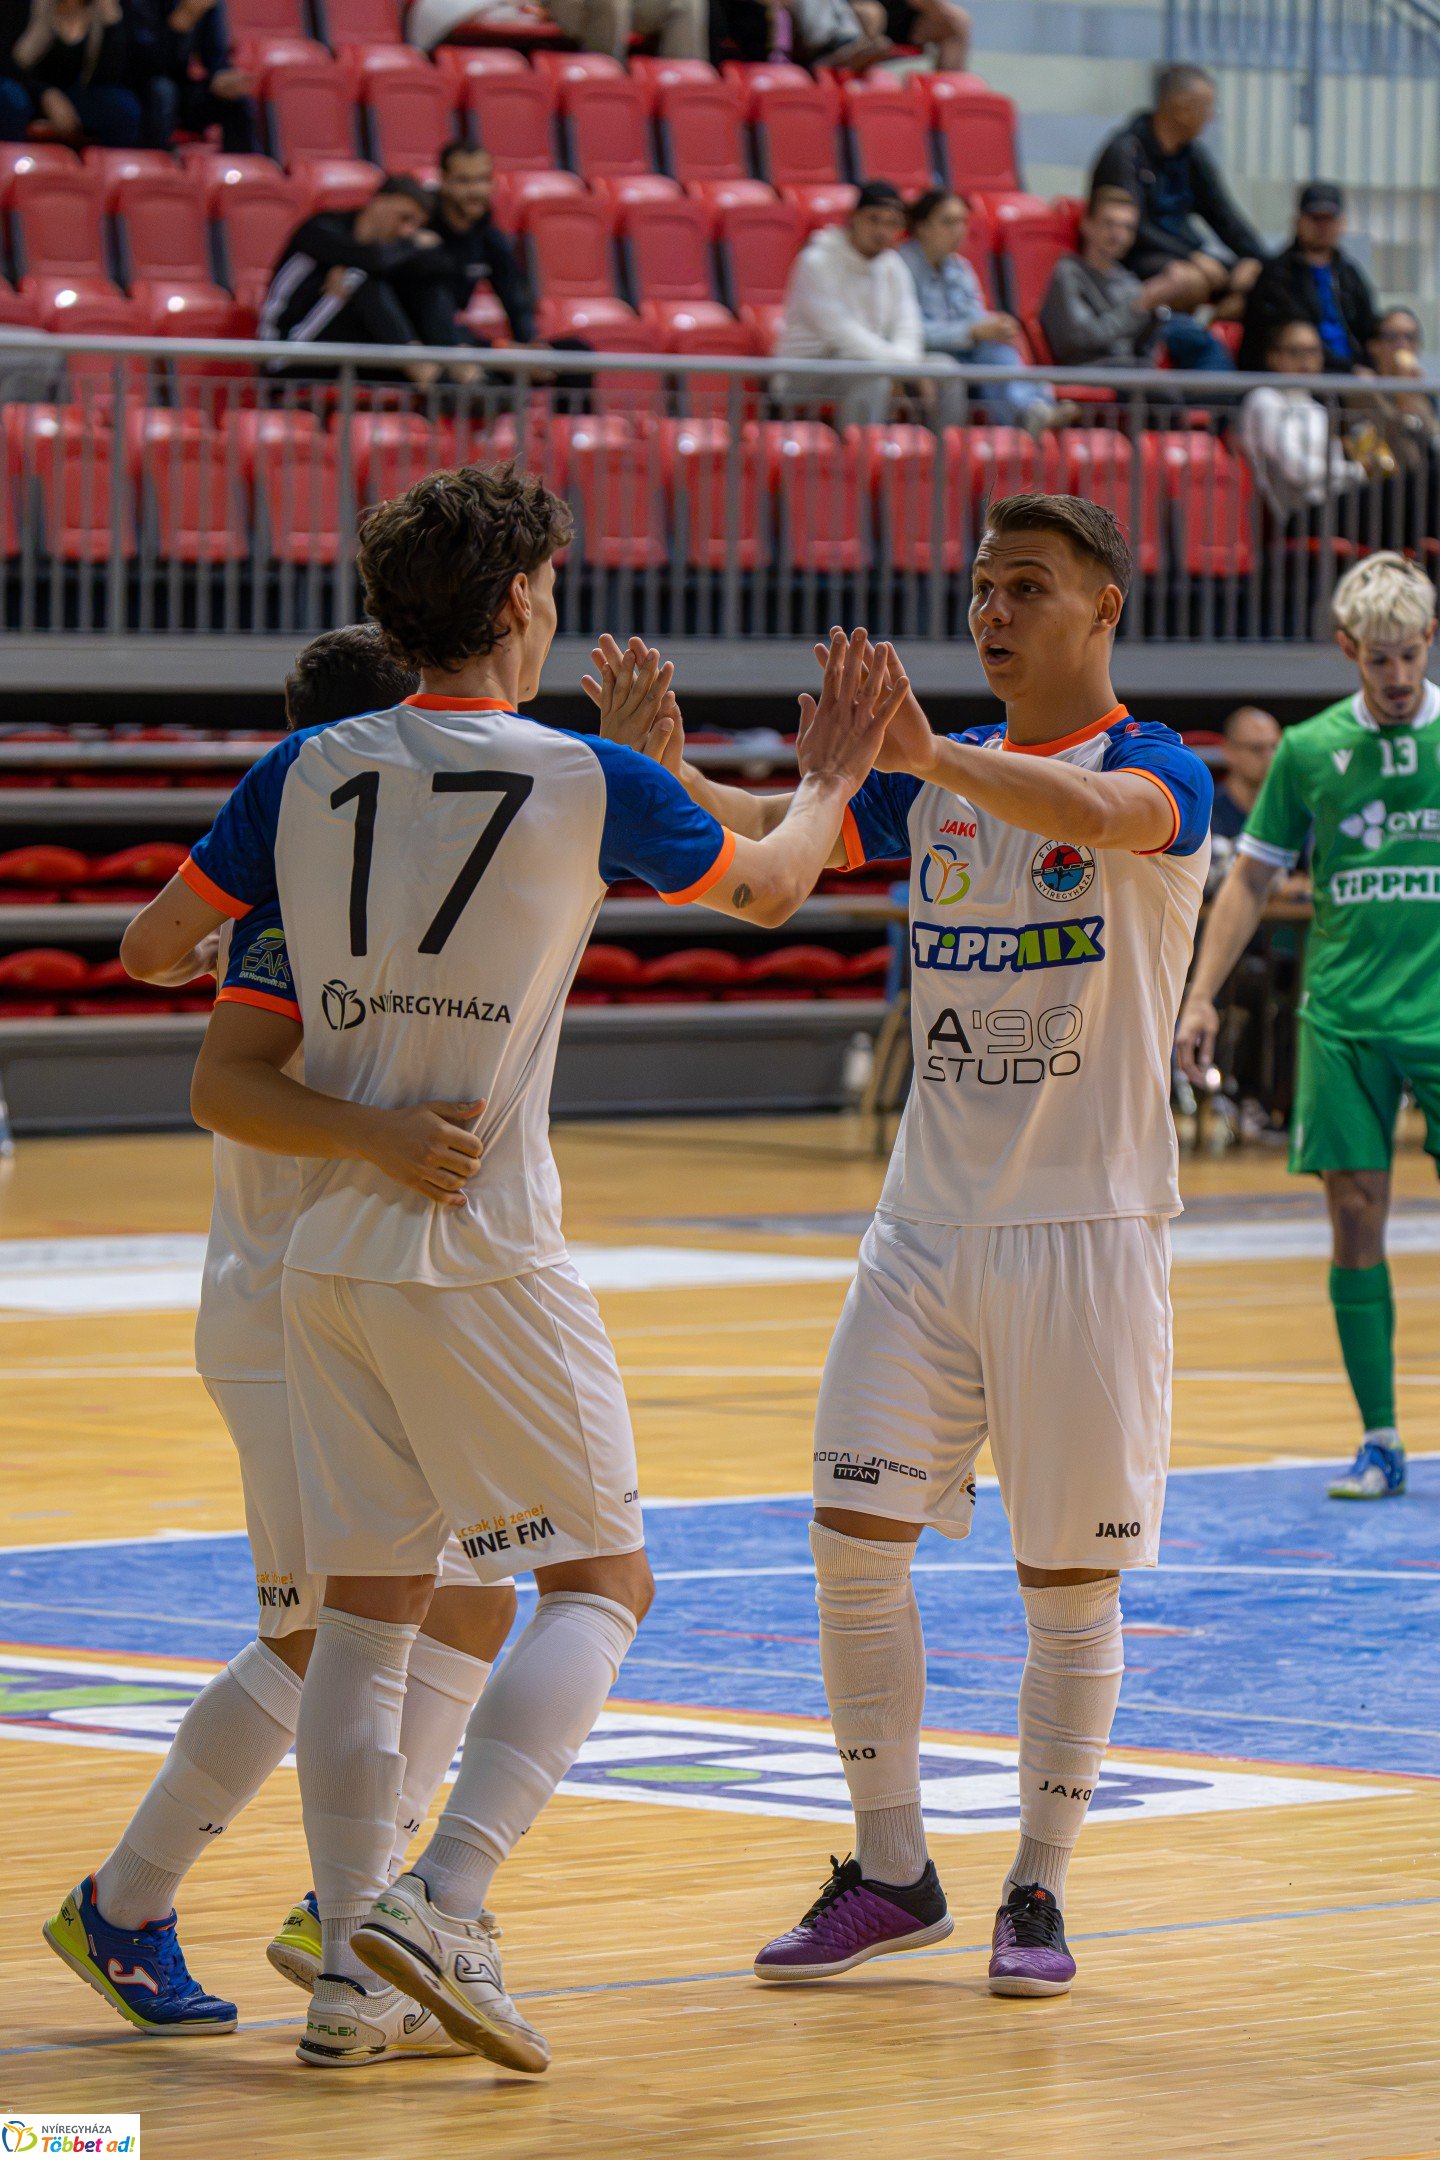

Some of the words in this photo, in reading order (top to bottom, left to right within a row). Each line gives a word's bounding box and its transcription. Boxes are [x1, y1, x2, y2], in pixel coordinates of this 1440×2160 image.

[1380, 735, 1418, 777] 13
[939, 818, 977, 838] JAKO
[330, 770, 535, 957] 17
[369, 990, 512, 1024] NYÍREGYHÁZA
[516, 1516, 556, 1545] FM
[1095, 1521, 1141, 1538] JAKO
[1038, 1780, 1092, 1801] JAKO
